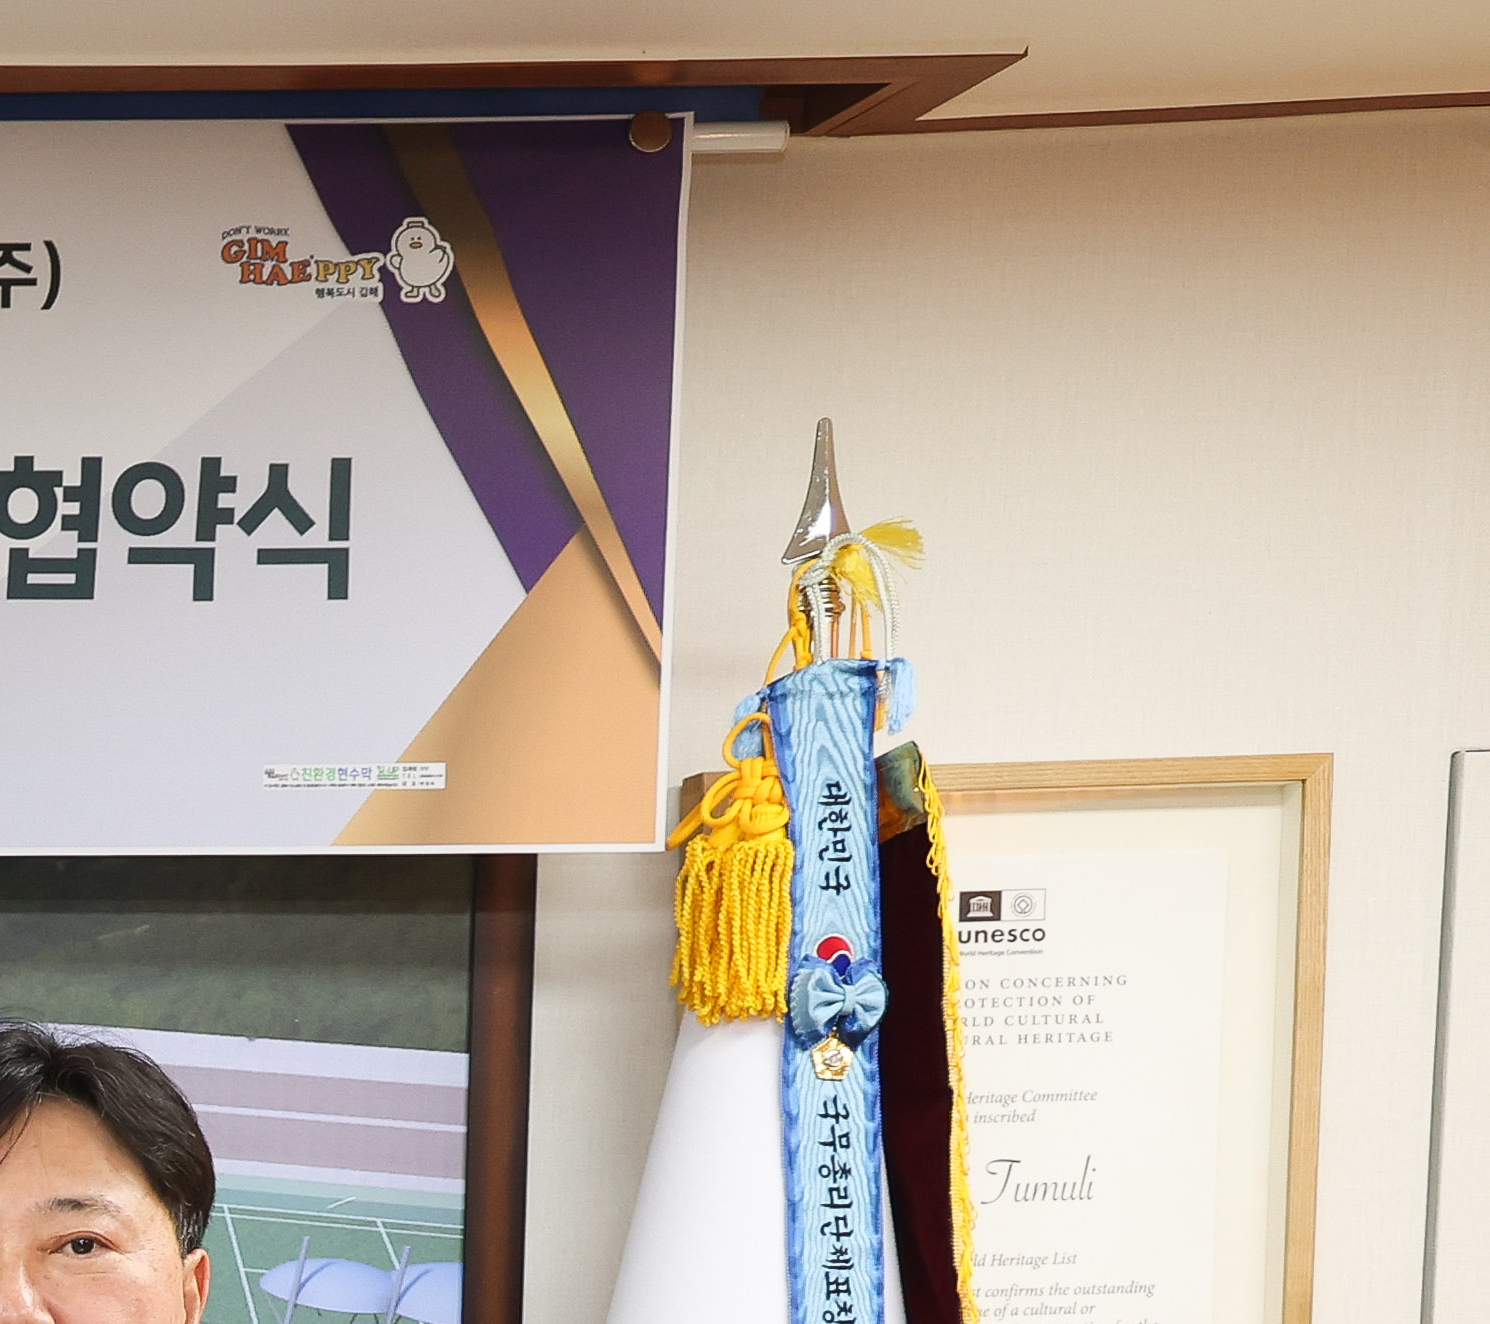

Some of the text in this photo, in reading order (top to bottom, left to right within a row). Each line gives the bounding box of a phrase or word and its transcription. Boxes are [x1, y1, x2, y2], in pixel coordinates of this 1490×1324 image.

[221, 238, 288, 264] GIM
[315, 287, 379, 299] 행복도시 김해
[816, 779, 852, 897] 대한민국
[958, 928, 1046, 944] unesco
[1000, 974, 1128, 990] CONCERNING
[1072, 993, 1097, 1006] OF
[1004, 1012, 1105, 1027] CULTURAL
[1018, 1031, 1114, 1046] HERITAGE
[1022, 1088, 1098, 1104] Committee
[973, 1109, 1036, 1124] inscribed
[980, 1154, 1097, 1205] Tumuli
[991, 1252, 1078, 1270] Heritage List
[984, 1279, 1156, 1302] confirms the outstanding
[993, 1302, 1095, 1320] of a cultural or
